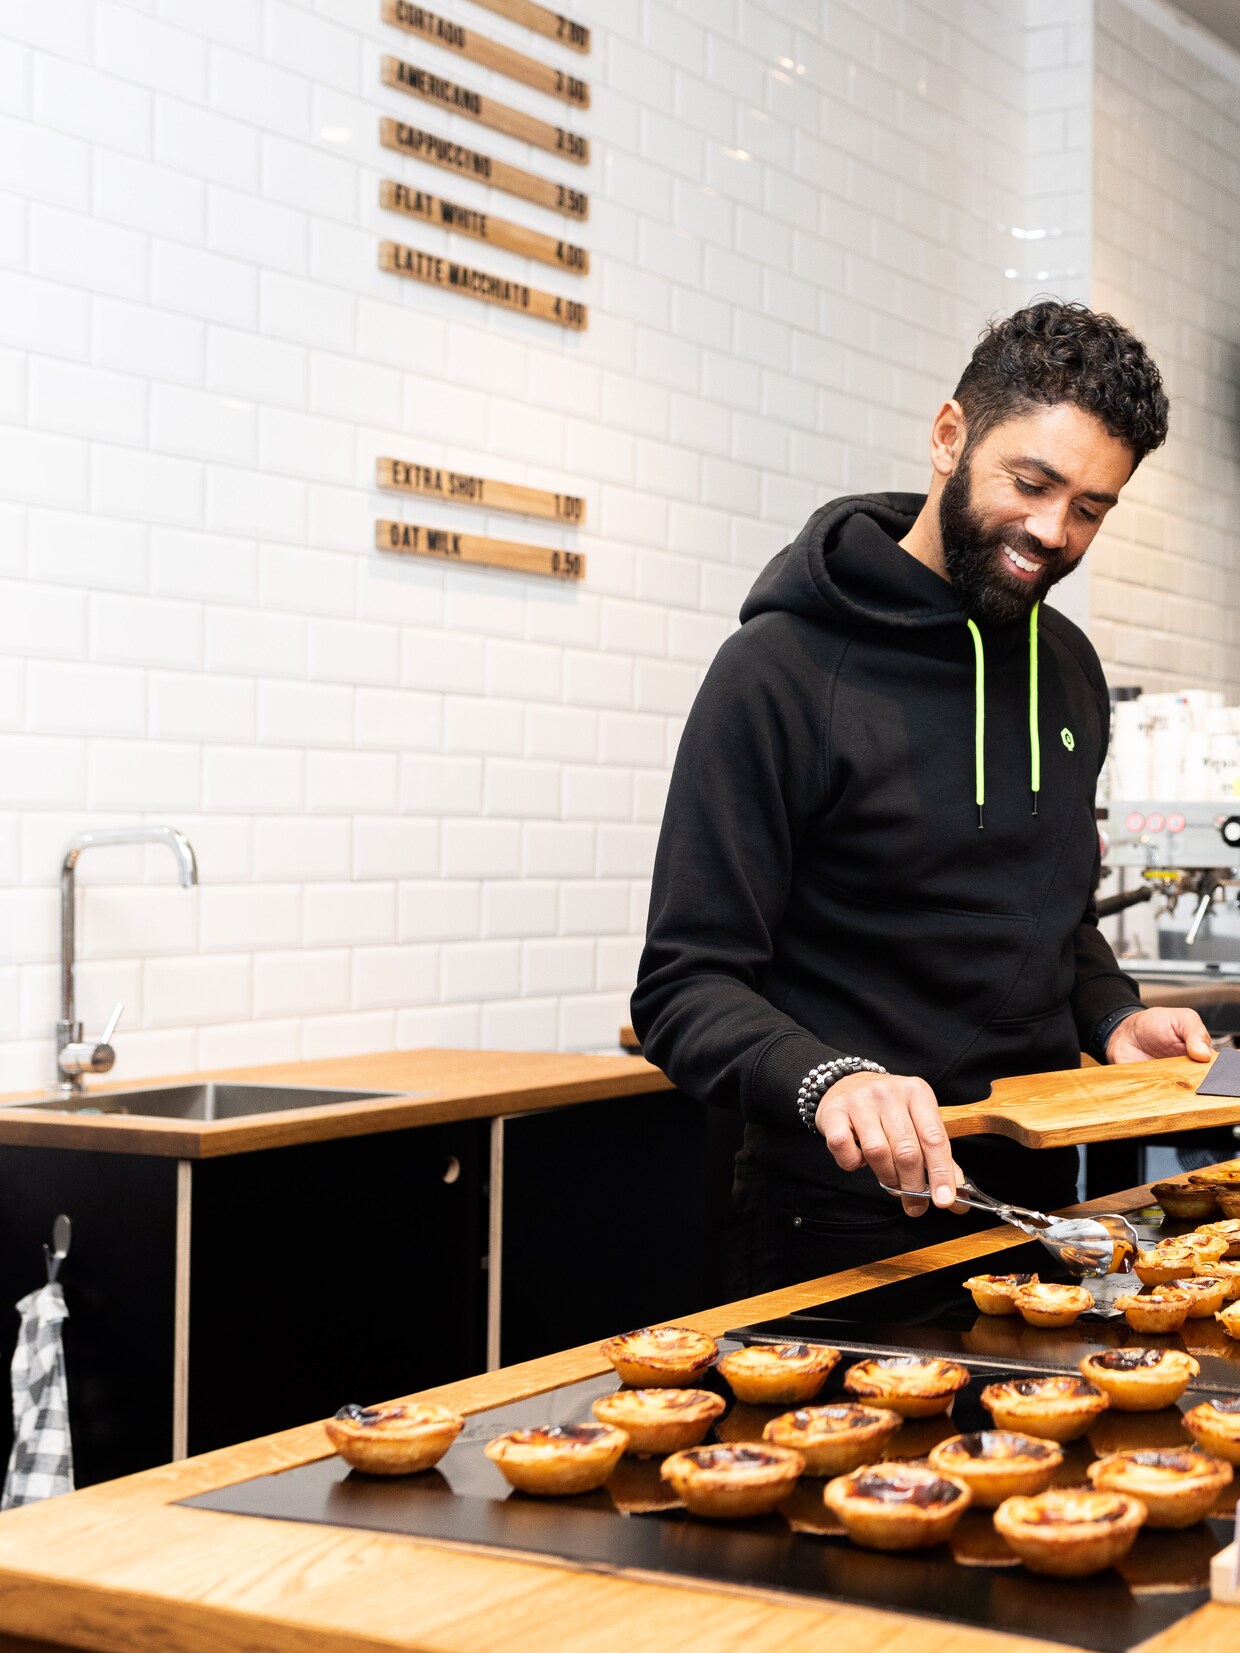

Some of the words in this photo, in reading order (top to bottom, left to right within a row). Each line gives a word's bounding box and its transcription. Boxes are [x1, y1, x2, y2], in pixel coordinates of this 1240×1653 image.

[395, 0, 466, 49] CORTADO
[396, 60, 482, 116] AMERICANO
[395, 121, 492, 179] CAPPUCCINO
[394, 182, 433, 218] FLAT
[440, 199, 488, 239] WHITE
[392, 246, 443, 284] LATTE
[447, 260, 530, 309] MACCHIATO
[392, 459, 443, 491] EXTRA
[448, 473, 485, 501] SHOT
[390, 523, 419, 549] OAT
[426, 529, 462, 555] MILK
